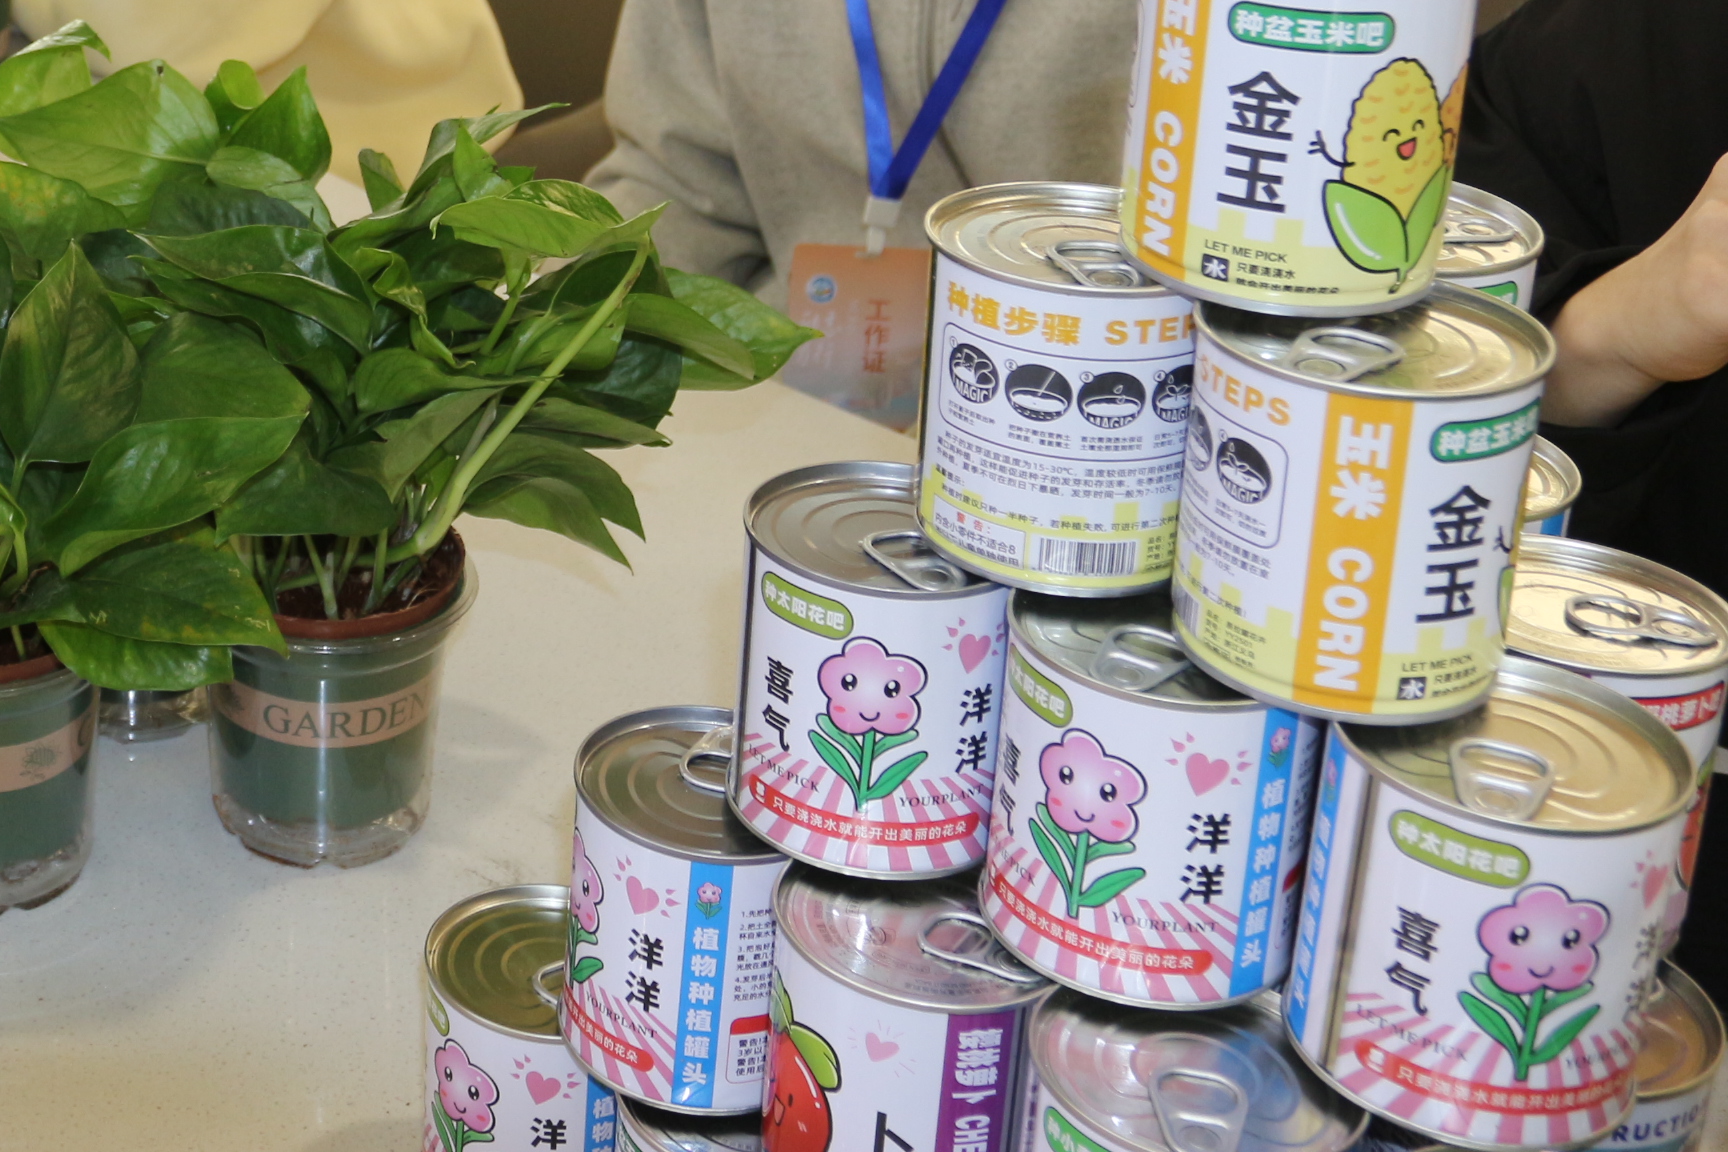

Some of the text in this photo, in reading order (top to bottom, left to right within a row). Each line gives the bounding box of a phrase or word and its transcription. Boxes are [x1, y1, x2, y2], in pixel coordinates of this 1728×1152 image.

[1234, 7, 1385, 48] 种盆玉米吧
[1216, 70, 1303, 214] 金玉
[1143, 110, 1184, 258] CORN
[1204, 239, 1288, 263] LET ME PICK
[864, 300, 892, 374] 工作证
[948, 281, 1082, 346] 种植步骤
[1200, 353, 1292, 426] STEPS
[1313, 415, 1393, 692] 玉米 CORN
[1416, 485, 1491, 624] 金玉
[765, 580, 846, 631] 种太阳花吧
[762, 655, 794, 753] 喜气
[1402, 661, 1427, 672] LET
[1430, 659, 1447, 669] ME
[955, 683, 993, 774] 洋洋
[773, 796, 967, 842] 只要浇浇水就能开出美丽的花朵
[1180, 813, 1232, 904] 洋洋
[1397, 818, 1521, 880] 种太阳花吧
[999, 881, 1194, 969] 只要浇浇水就能开出美丽的花朵
[1385, 905, 1441, 1017] 喜气
[625, 928, 664, 1014] 洋洋
[682, 926, 720, 1086] 植物种植罐头
[530, 1117, 567, 1151] 洋
[592, 1095, 616, 1152] 植物
